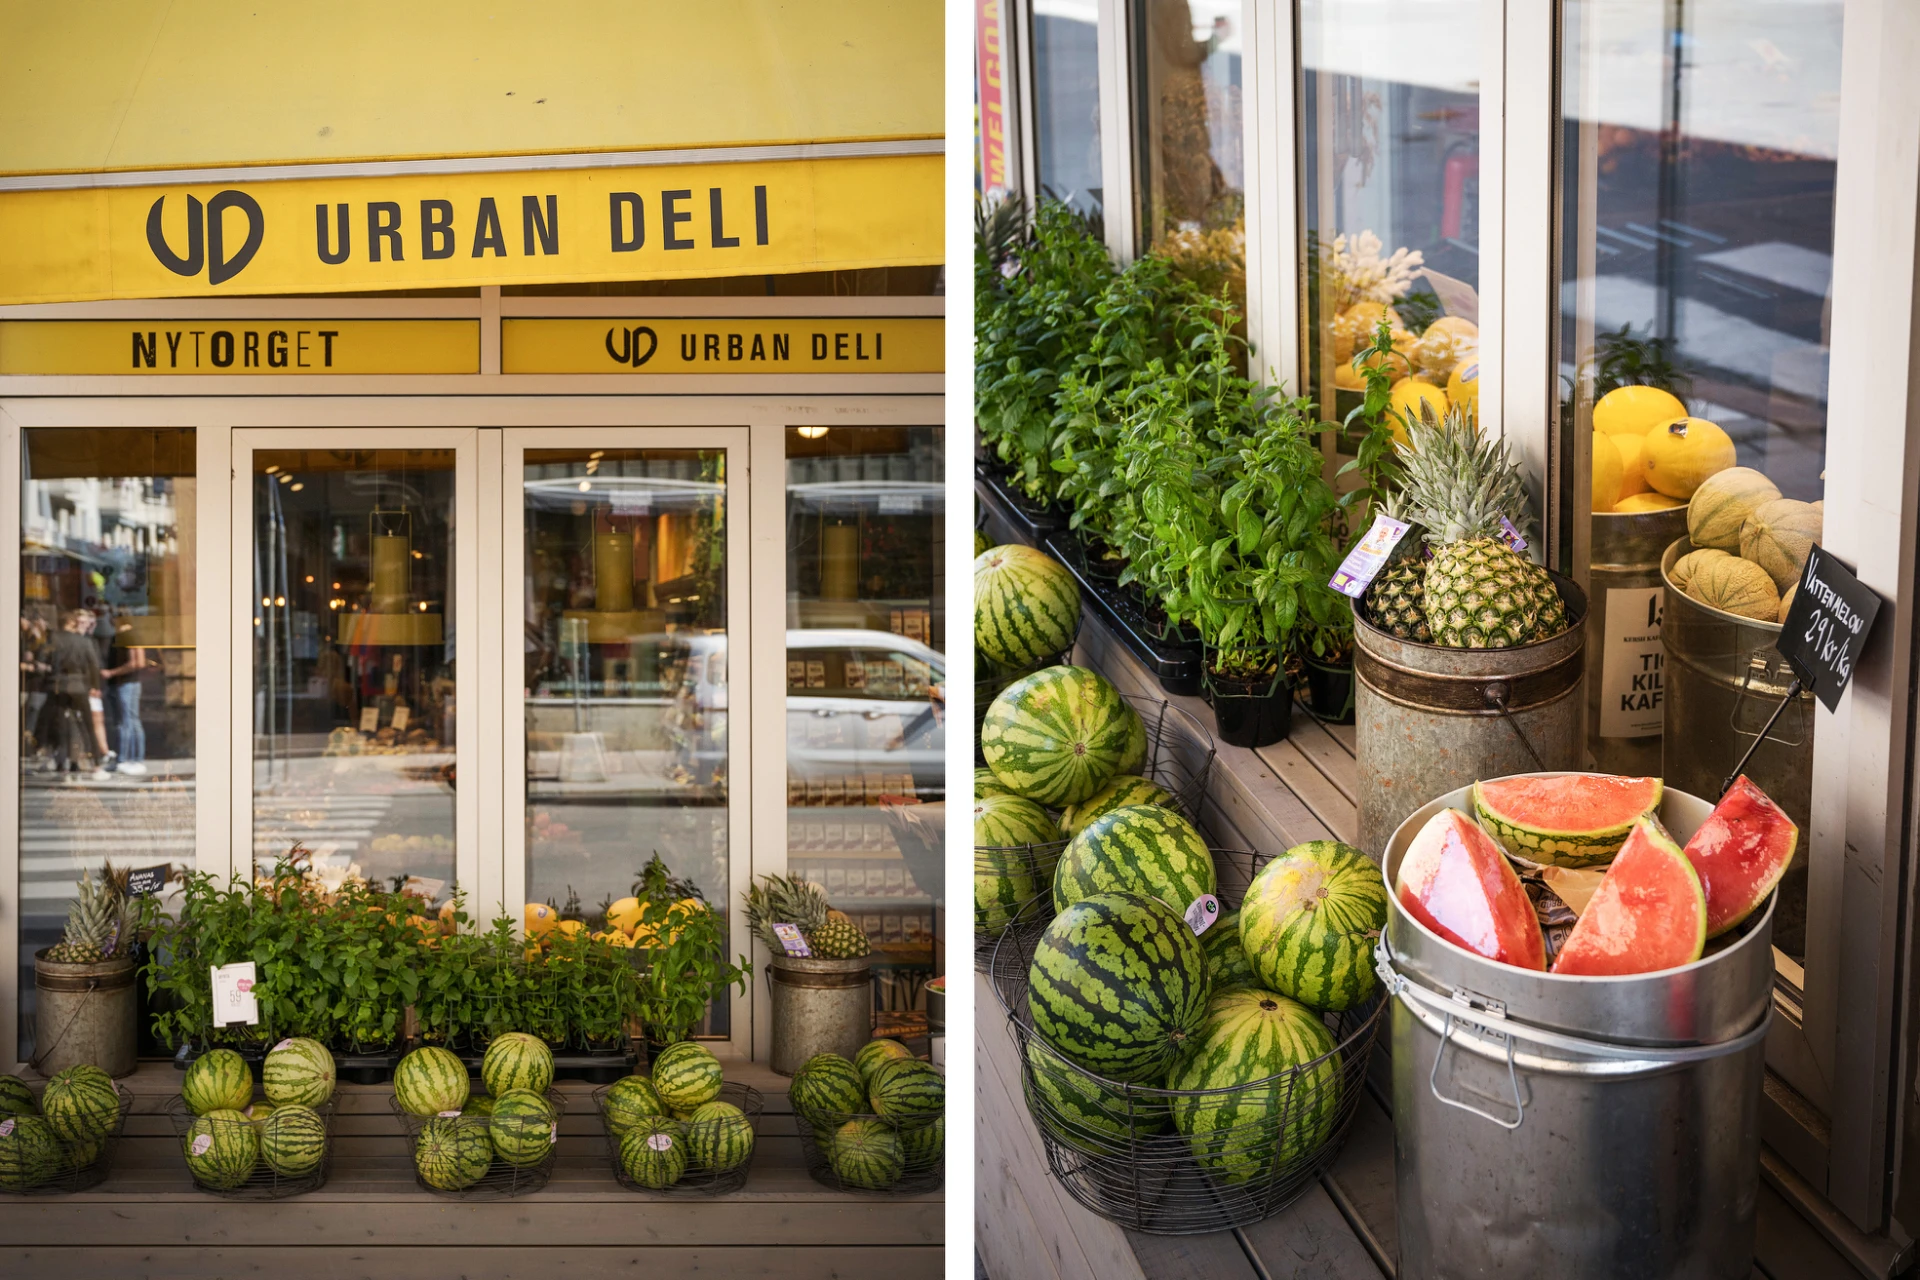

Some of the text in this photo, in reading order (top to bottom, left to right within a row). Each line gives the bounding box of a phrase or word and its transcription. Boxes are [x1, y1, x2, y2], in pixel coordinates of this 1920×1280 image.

[315, 195, 559, 265] URBAN
[609, 185, 769, 253] DELI
[132, 330, 339, 368] NYTORGET
[681, 333, 790, 361] URBAN
[811, 332, 882, 361] DELI
[1805, 552, 1865, 635] VATTENMELON
[1639, 652, 1664, 671] TI
[229, 990, 242, 1003] 59
